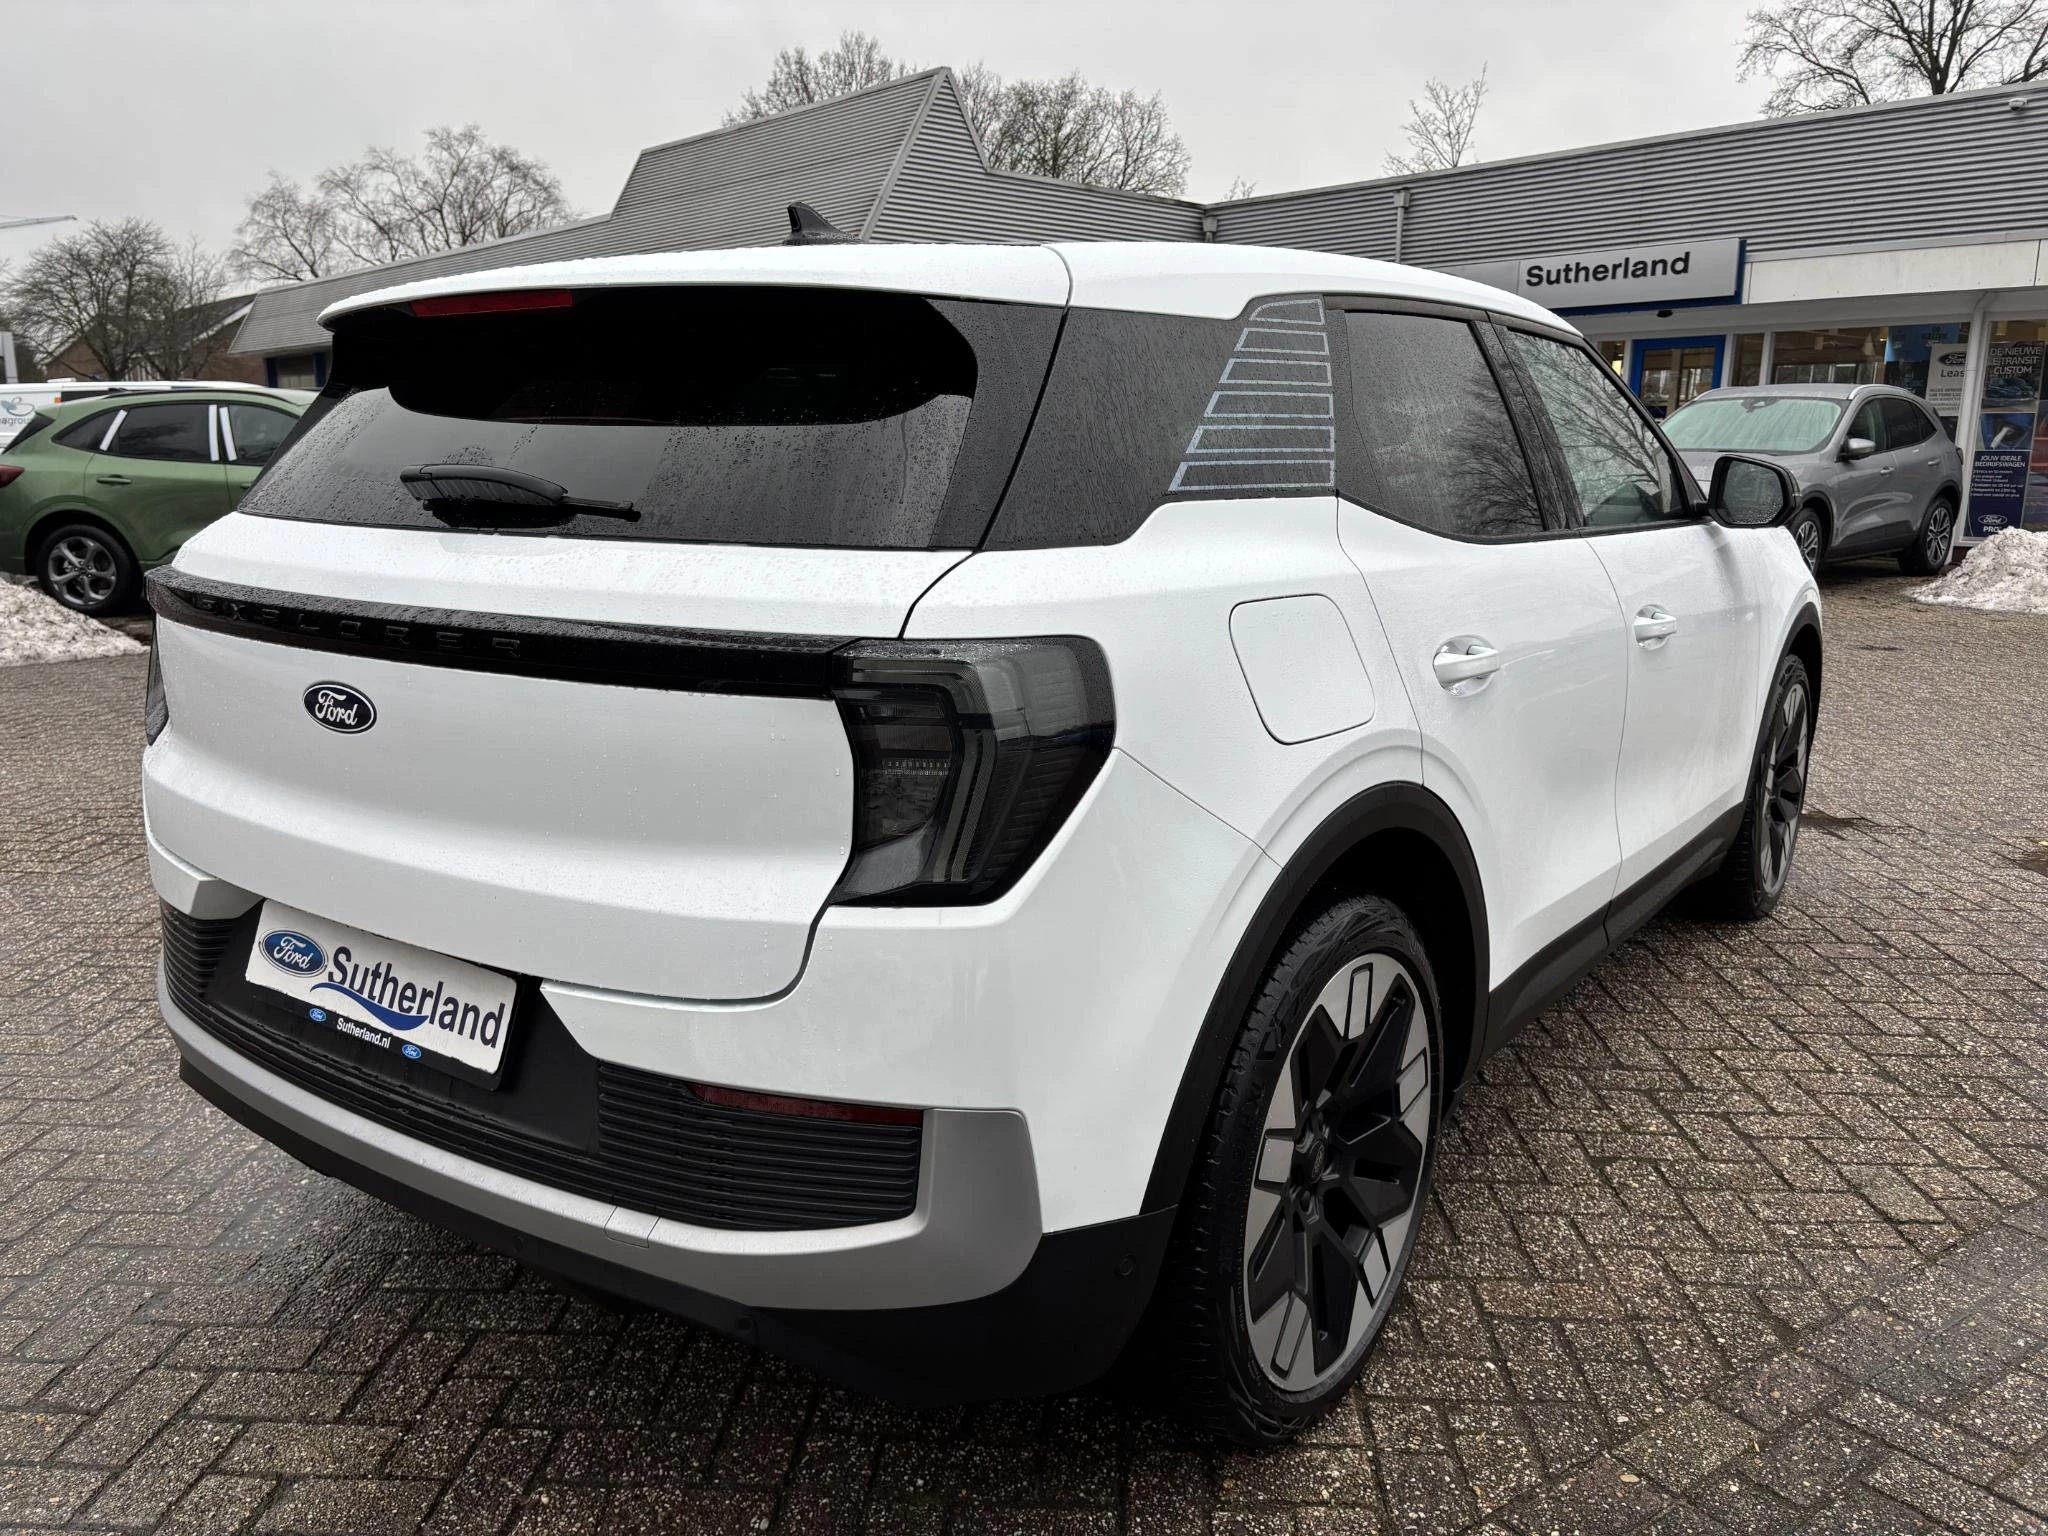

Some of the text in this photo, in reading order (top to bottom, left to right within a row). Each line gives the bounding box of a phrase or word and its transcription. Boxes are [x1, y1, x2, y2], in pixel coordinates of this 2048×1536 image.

[1526, 251, 1691, 287] Sutherland
[1990, 346, 2041, 356] DE NIEUWE
[1941, 368, 1966, 378] Leas
[1994, 366, 2033, 375] CUSTOM
[193, 596, 522, 659] EXPLORER
[314, 689, 359, 727] Ford
[273, 935, 506, 1049] Ford Sutherland
[336, 1018, 392, 1049] Sutherland.nl
